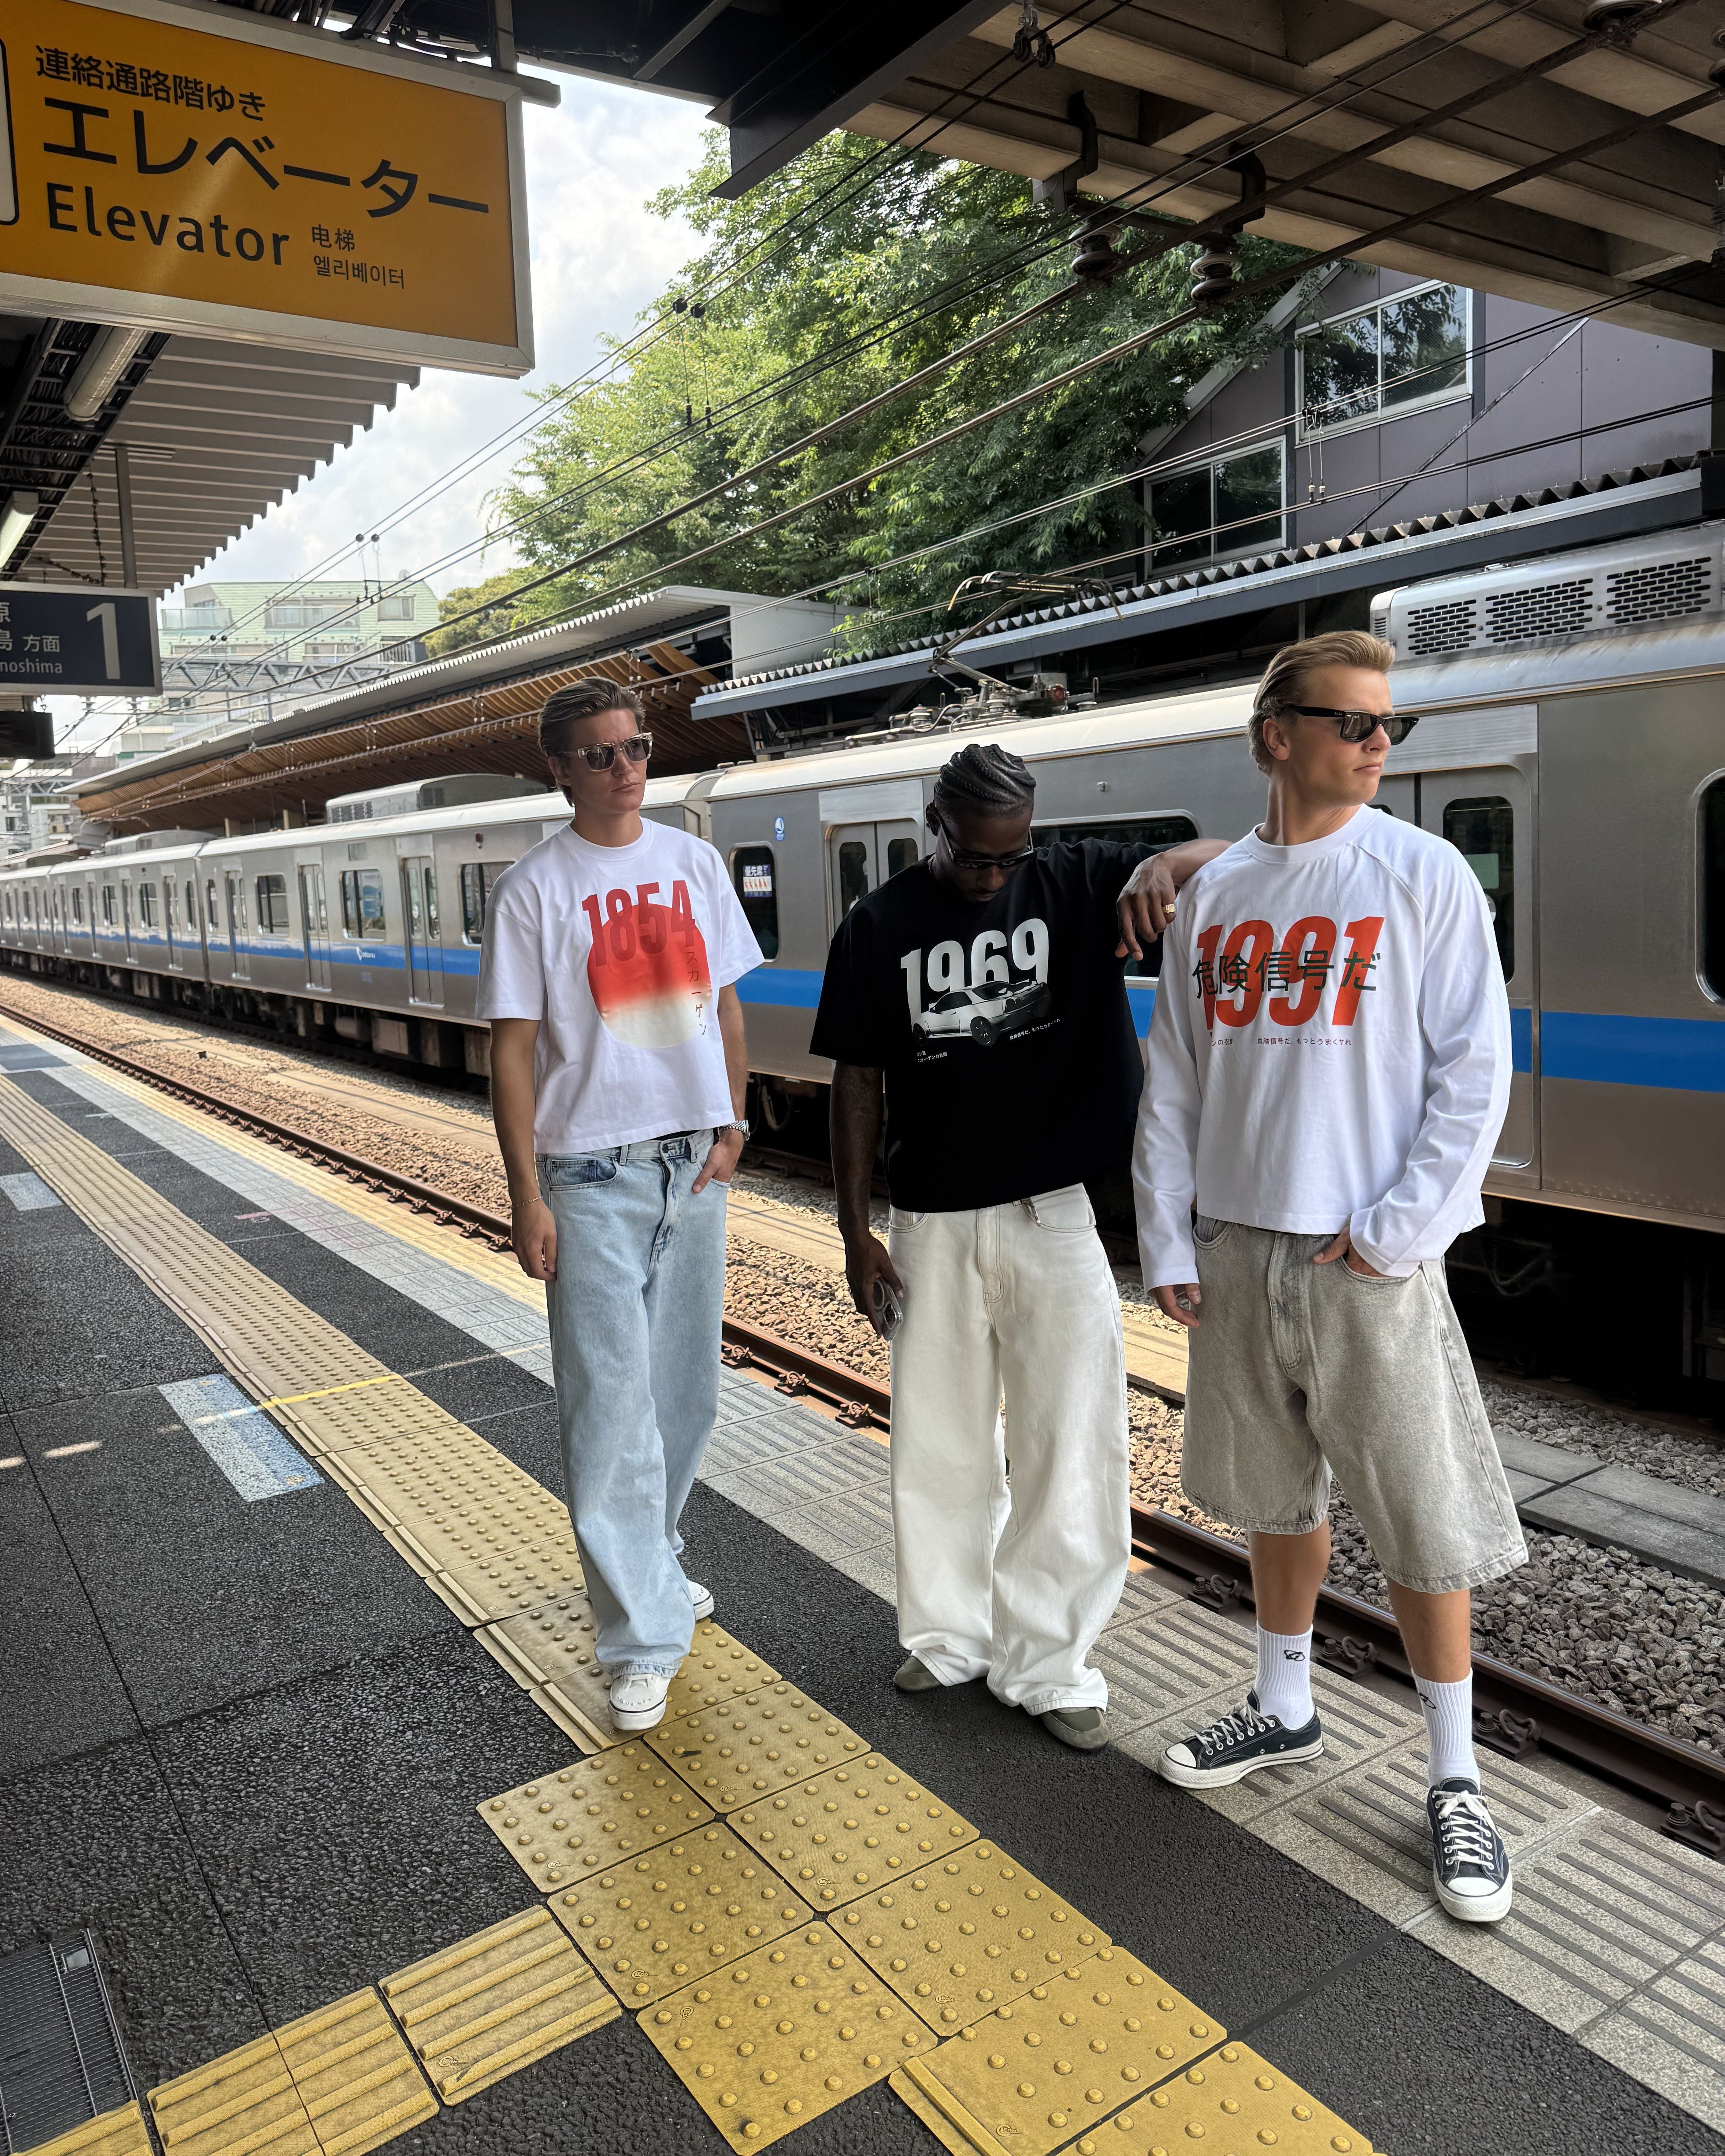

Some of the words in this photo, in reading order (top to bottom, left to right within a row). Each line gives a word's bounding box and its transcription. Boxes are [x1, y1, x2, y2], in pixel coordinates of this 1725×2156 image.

[35, 45, 267, 121] 連絡通路階ゆき
[43, 97, 489, 218] エレベーター
[46, 182, 290, 266] Elevator
[312, 224, 355, 251] 电梯
[314, 255, 404, 289] 엘리베이터
[0, 658, 62, 674] noshima
[23, 634, 60, 652] 方面
[86, 602, 120, 680] 1
[581, 880, 695, 967] 1854
[685, 951, 707, 1035] スカーゲン
[900, 918, 1049, 1021] 1969
[1192, 950, 1381, 999] 危険信号だ
[1196, 916, 1385, 1030] 1991
